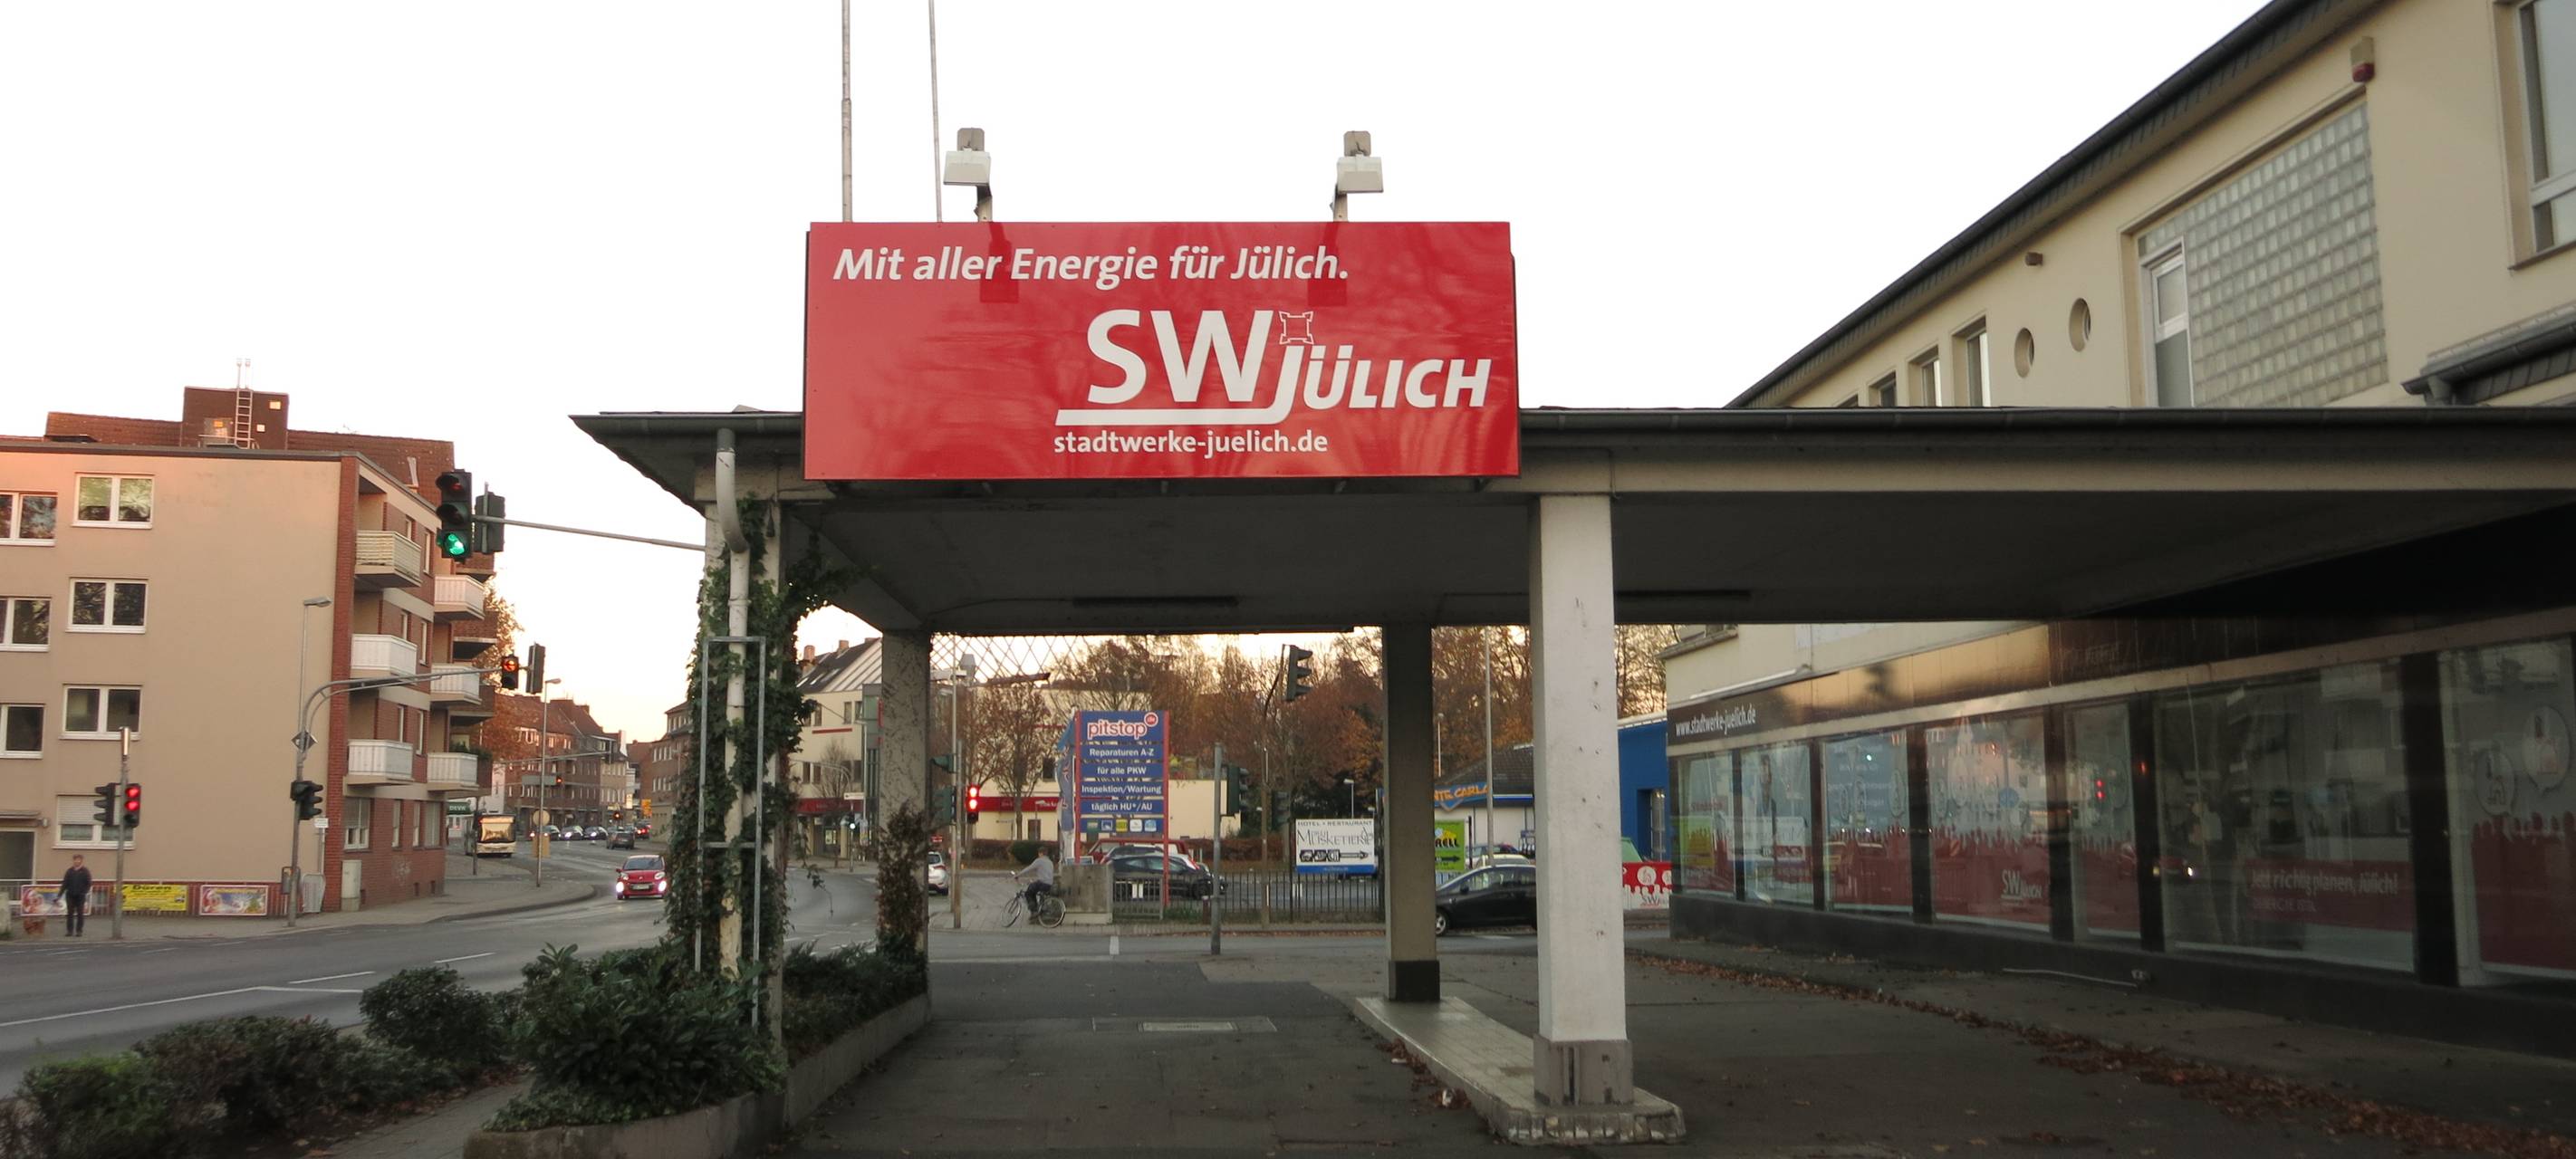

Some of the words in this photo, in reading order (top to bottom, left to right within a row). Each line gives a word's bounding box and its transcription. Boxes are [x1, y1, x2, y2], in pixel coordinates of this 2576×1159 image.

[832, 247, 905, 280] Mit
[913, 245, 1003, 281] aller
[1010, 246, 1158, 291] Energie
[1169, 245, 1225, 280] für
[1230, 245, 1349, 280] Jülich.
[1087, 309, 1274, 404] SW
[1053, 429, 1329, 459] stadtwerke-juelich.de
[1087, 719, 1148, 741] pitstop
[1675, 703, 1756, 736] www.stadtwerke-juelich.de
[1090, 748, 1139, 758] Reparaturen
[1140, 748, 1155, 757] A-Z
[1097, 767, 1109, 775] für
[1110, 767, 1125, 775] alle
[1127, 767, 1147, 775] PKW
[1081, 785, 1161, 795] Inspektion/Wartung
[1091, 803, 1119, 813] täglich
